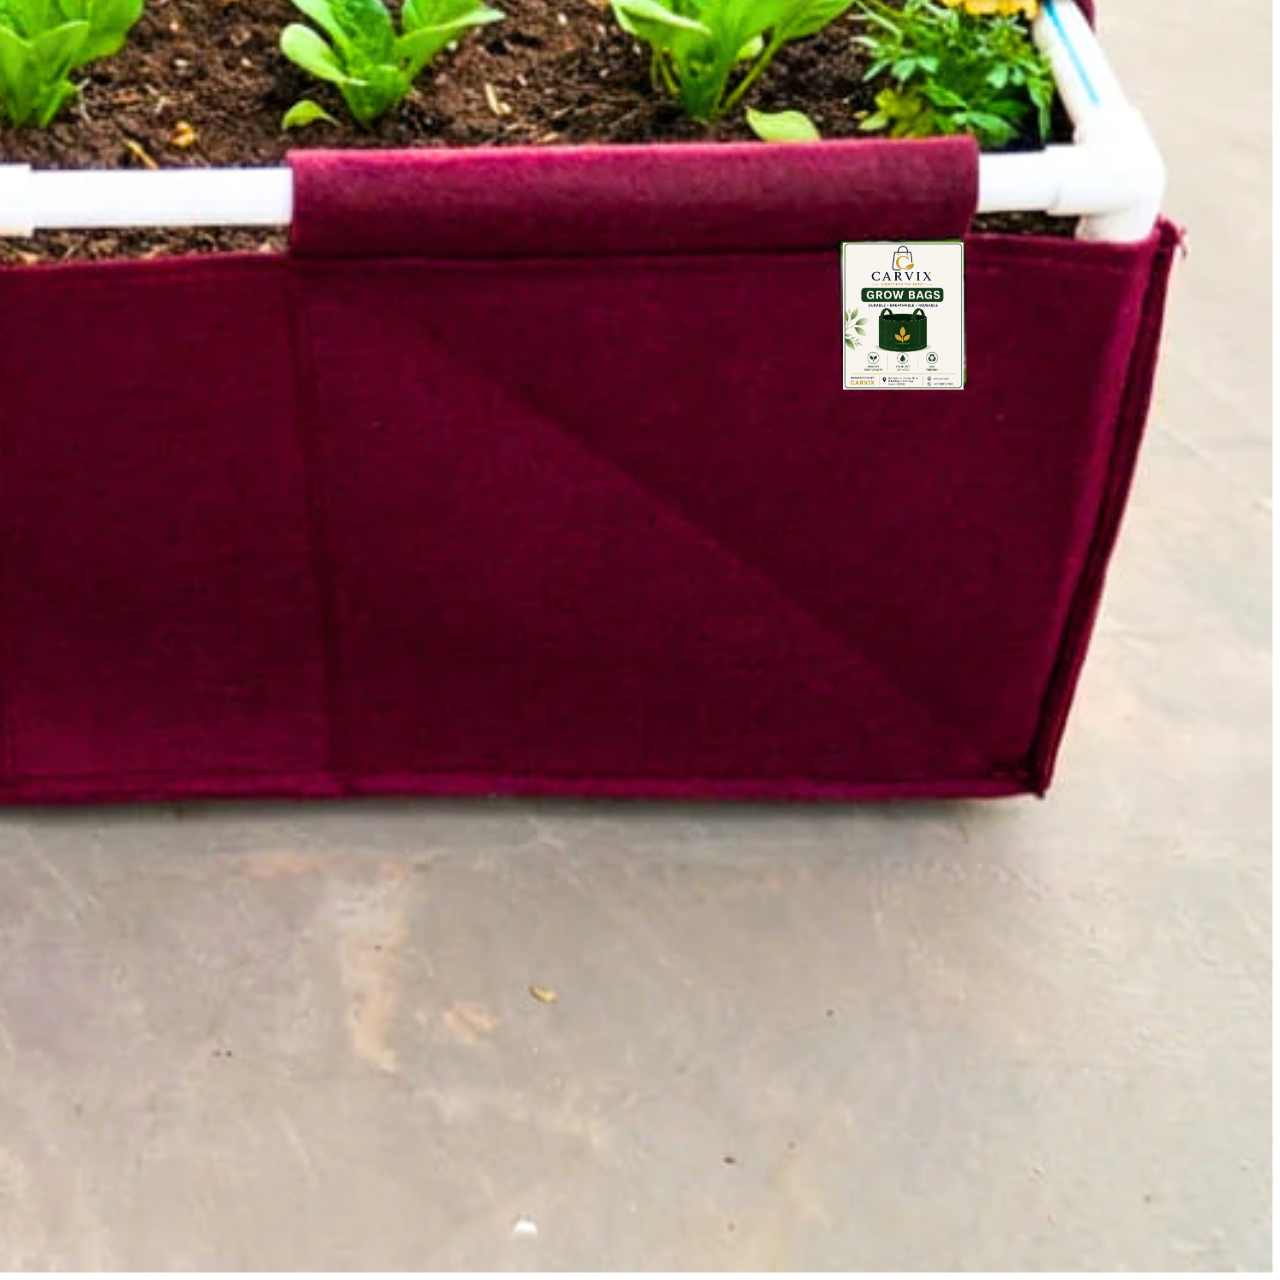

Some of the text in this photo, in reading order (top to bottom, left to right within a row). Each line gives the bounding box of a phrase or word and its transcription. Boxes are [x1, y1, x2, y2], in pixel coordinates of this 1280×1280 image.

[871, 271, 932, 281] CARVIX
[866, 290, 941, 300] GROW BAGS
